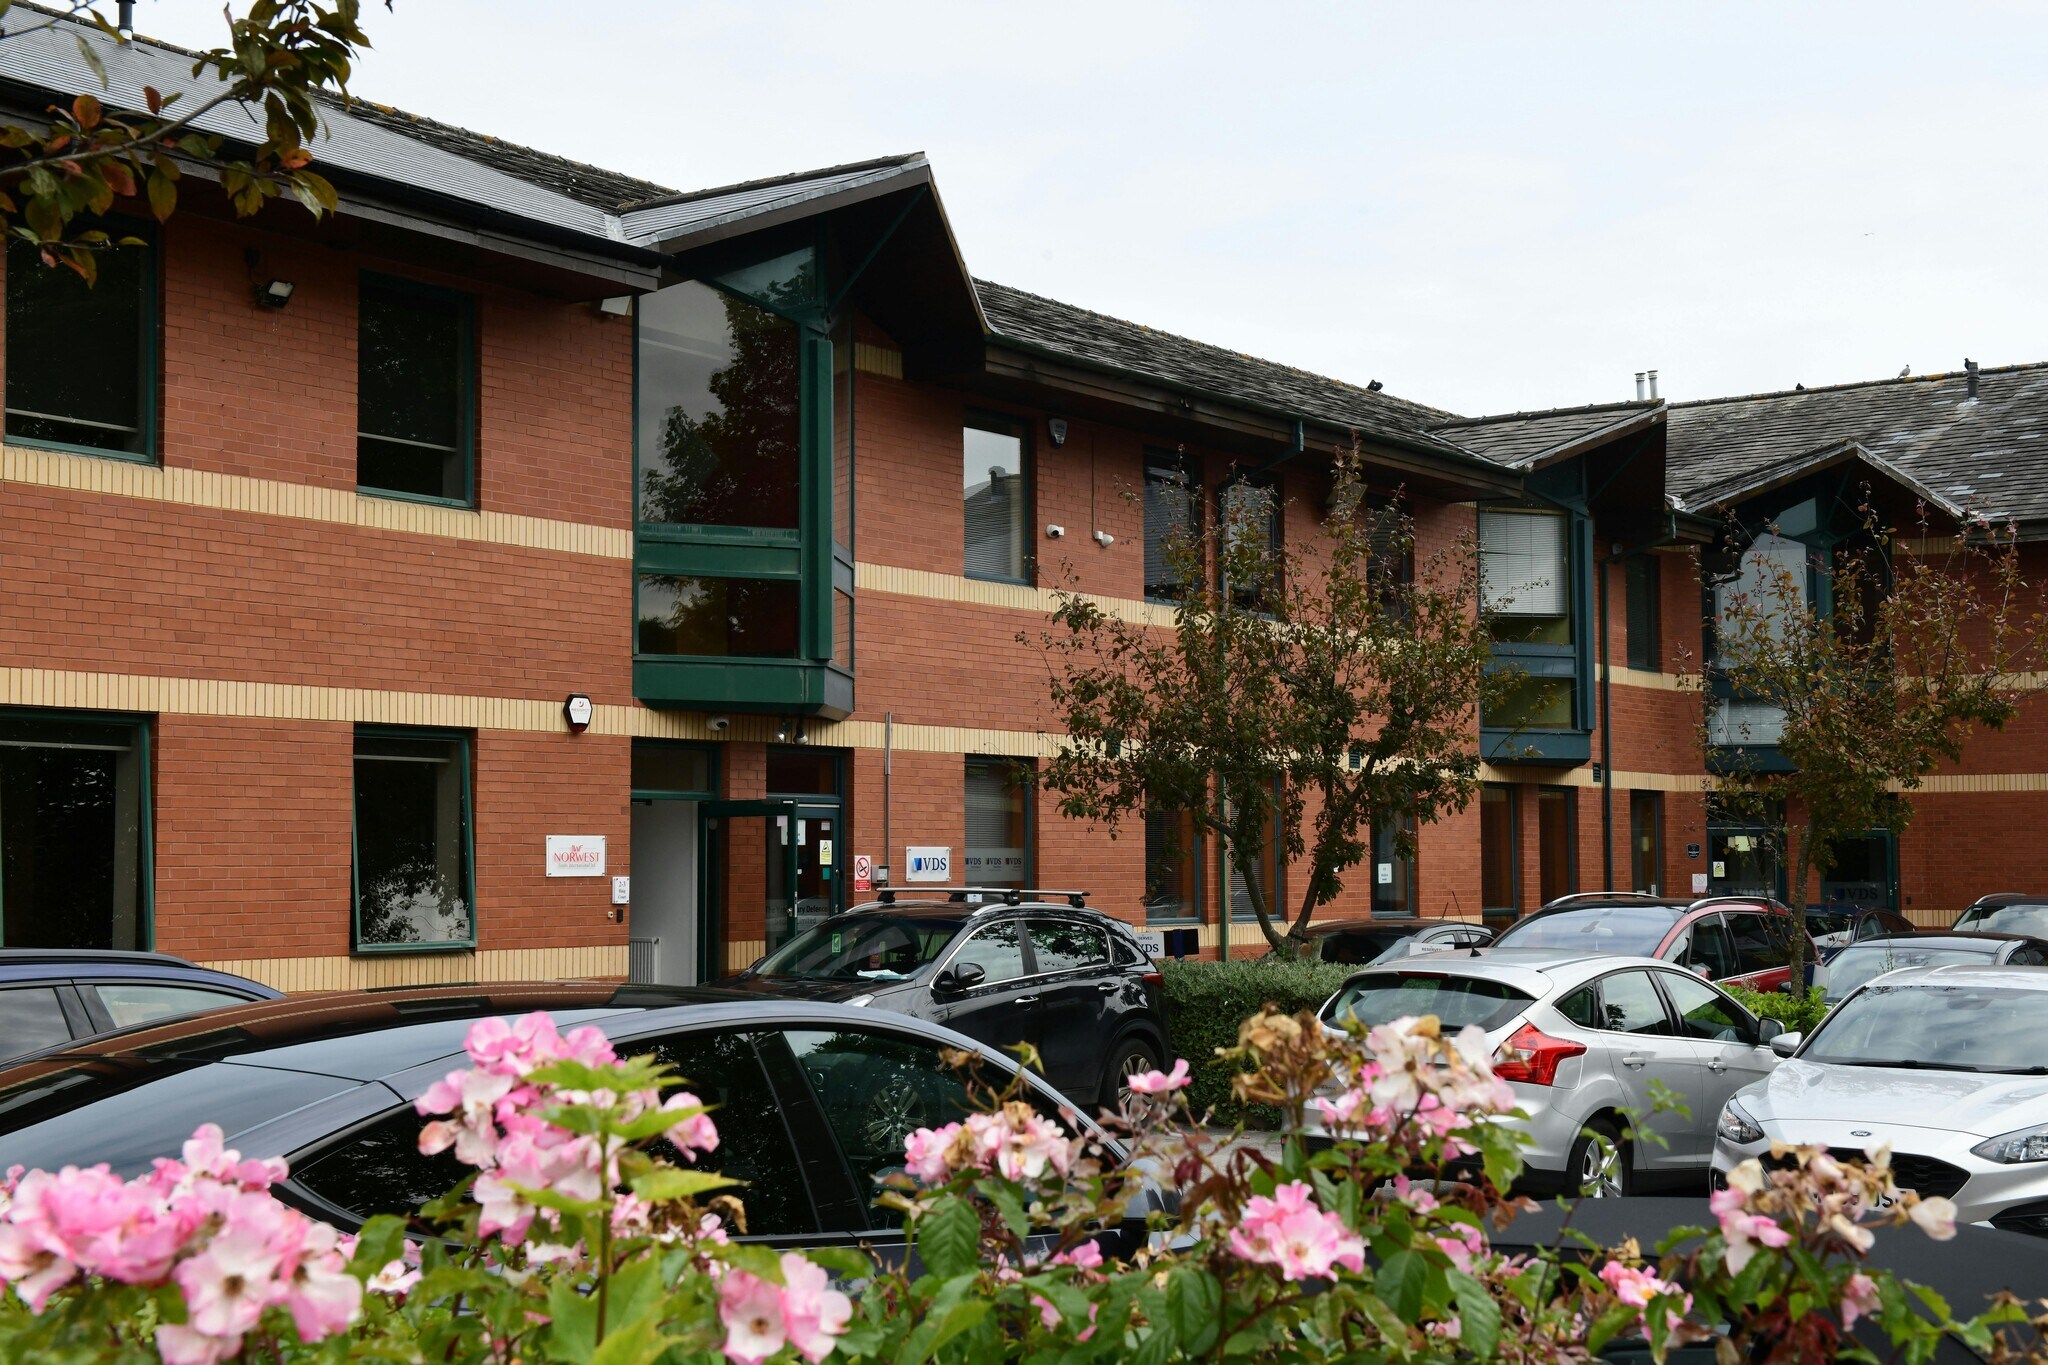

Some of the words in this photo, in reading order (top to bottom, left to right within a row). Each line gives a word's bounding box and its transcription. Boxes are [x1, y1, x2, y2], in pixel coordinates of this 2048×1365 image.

[554, 852, 600, 862] NORWEST
[969, 857, 982, 865] VDS
[989, 857, 1002, 865] VDS
[1009, 857, 1022, 865] VDS
[923, 857, 947, 871] VDS
[1846, 888, 1878, 899] VDS
[806, 905, 828, 913] Defence
